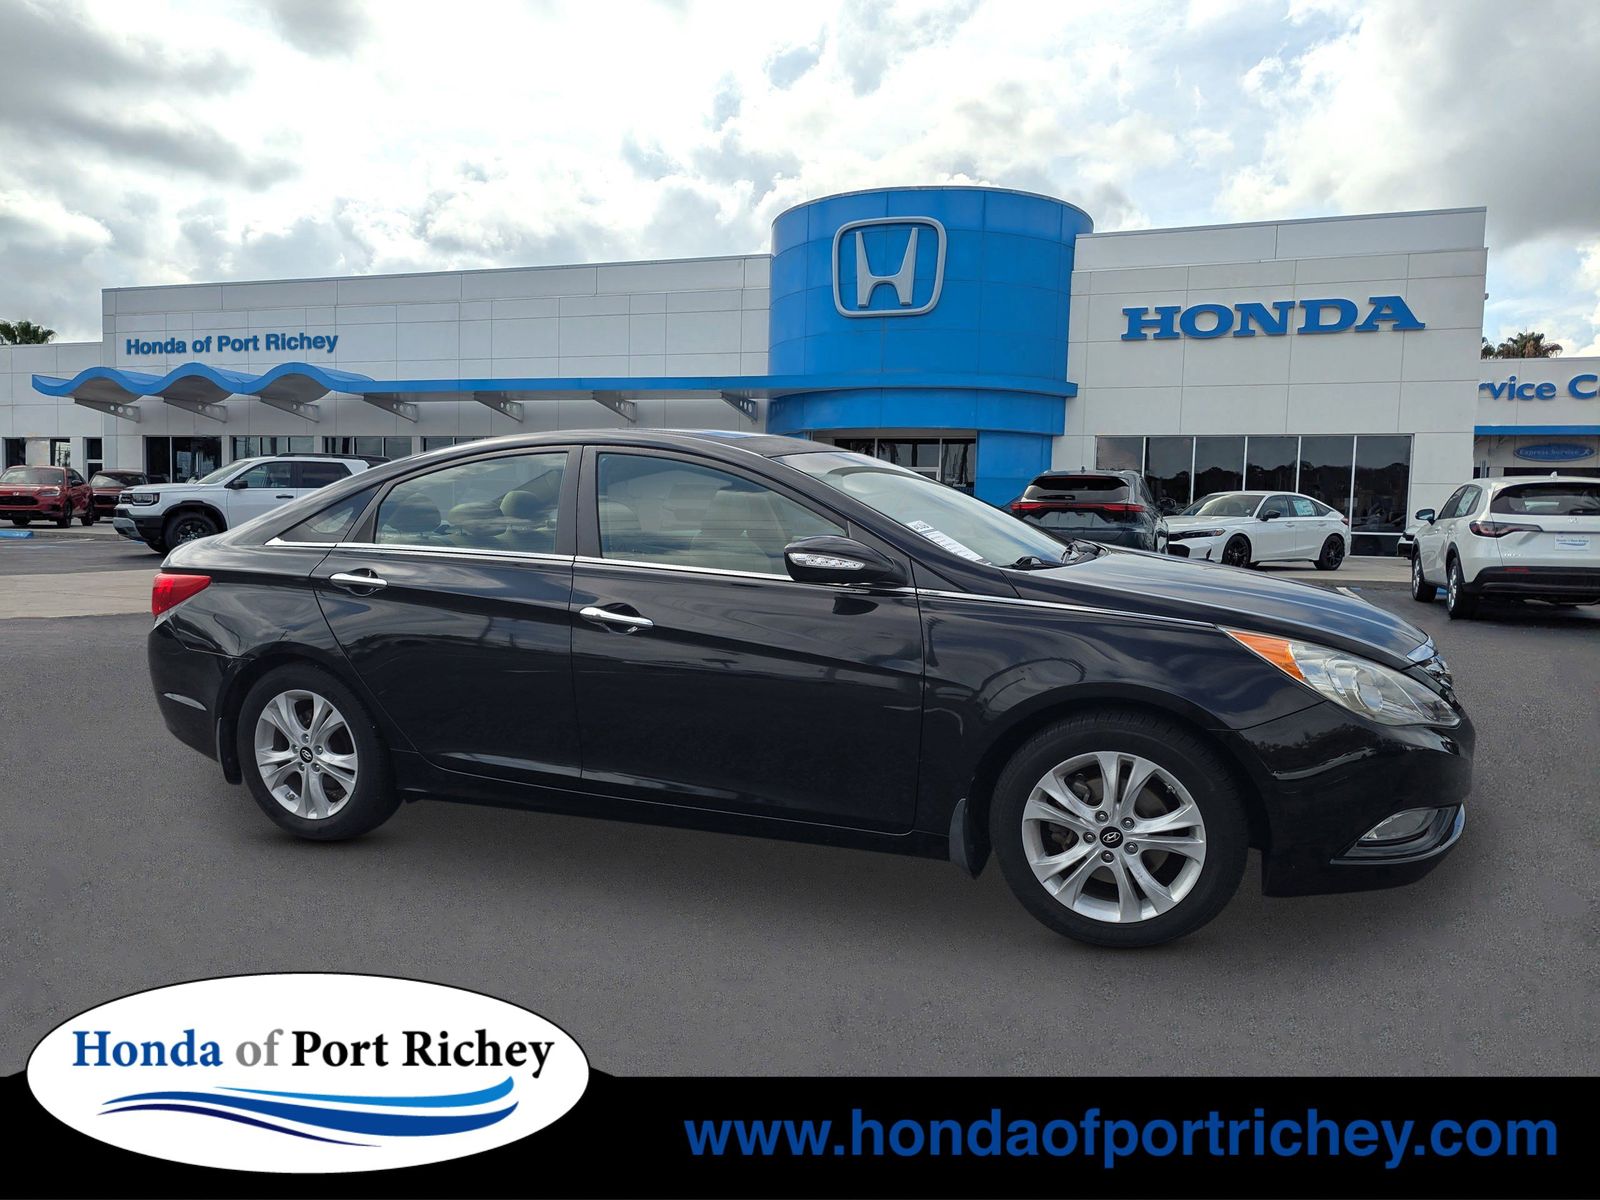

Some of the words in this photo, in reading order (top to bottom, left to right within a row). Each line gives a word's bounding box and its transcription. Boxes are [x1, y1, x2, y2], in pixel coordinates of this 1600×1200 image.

[1120, 294, 1426, 341] HONDA
[126, 337, 187, 355] Honda
[191, 335, 212, 353] of
[217, 335, 260, 352] Port
[265, 332, 339, 353] Richey
[1567, 374, 1600, 400] C
